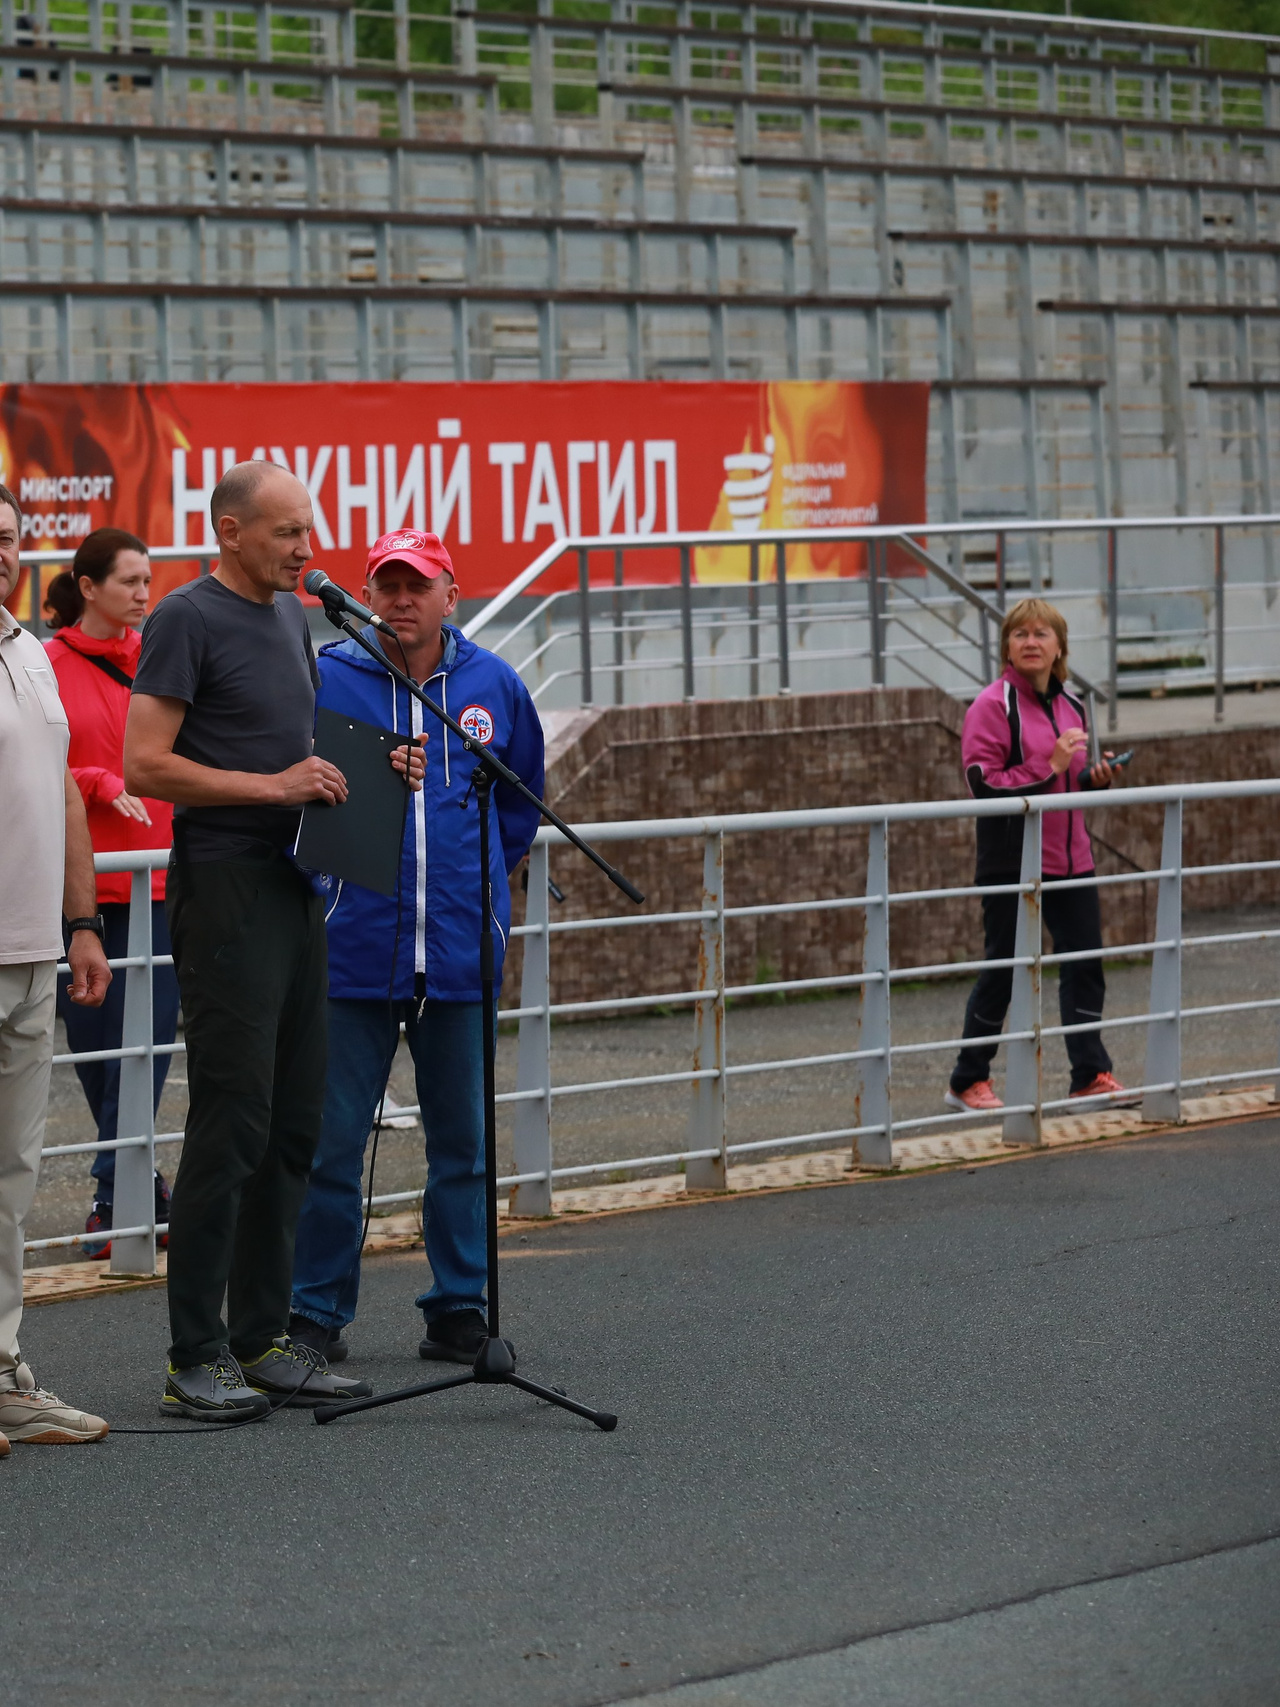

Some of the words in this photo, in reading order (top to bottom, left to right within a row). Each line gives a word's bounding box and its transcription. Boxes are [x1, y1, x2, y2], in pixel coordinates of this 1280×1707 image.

[20, 475, 113, 502] МИНСПОРТ
[172, 418, 471, 550] НЖНИЙ
[488, 439, 678, 543] ТАГИЛ
[20, 512, 91, 539] РОССИИ
